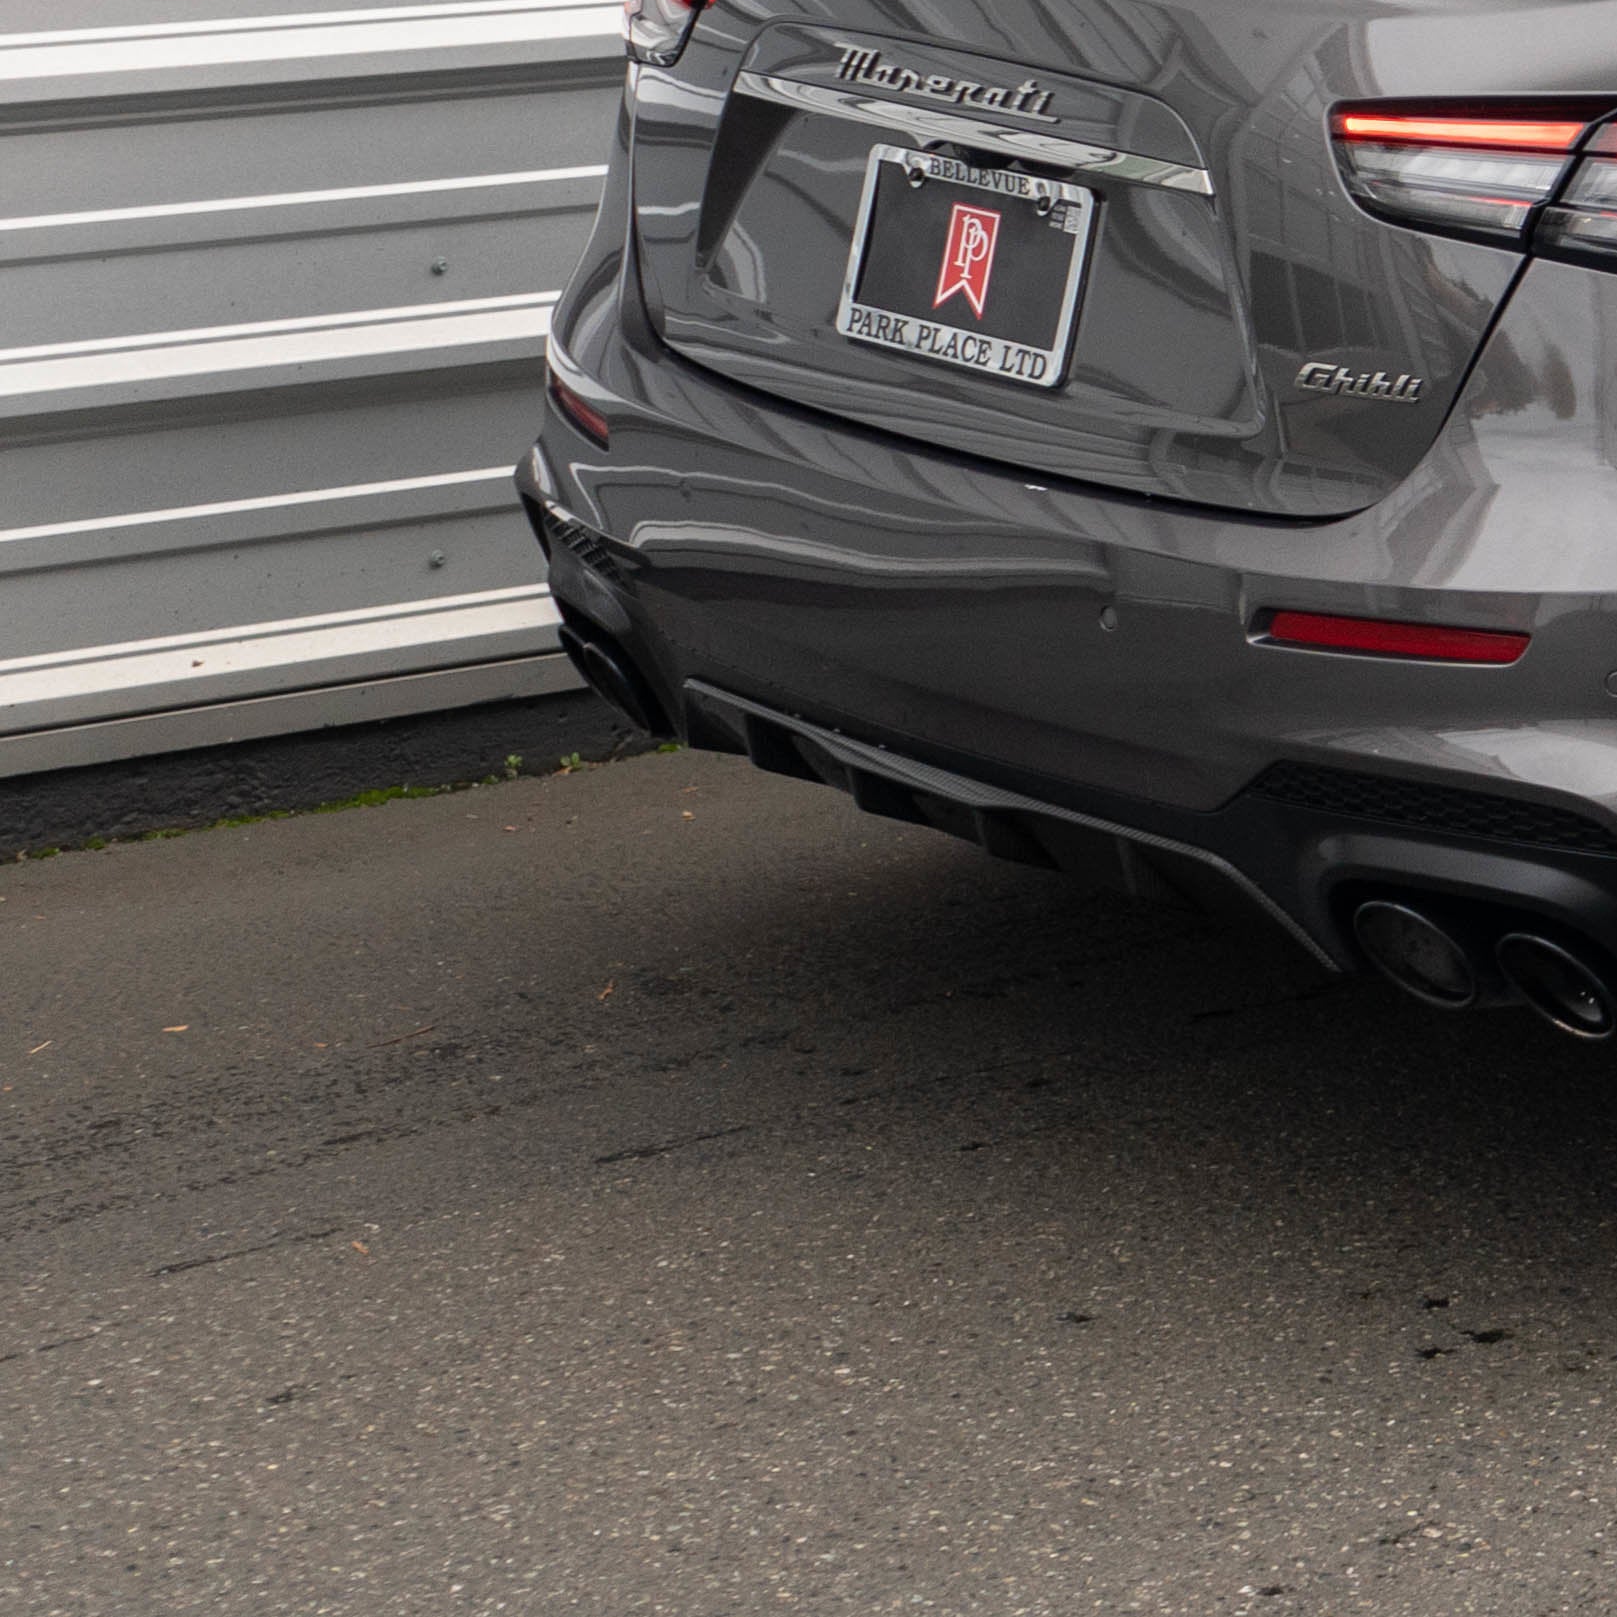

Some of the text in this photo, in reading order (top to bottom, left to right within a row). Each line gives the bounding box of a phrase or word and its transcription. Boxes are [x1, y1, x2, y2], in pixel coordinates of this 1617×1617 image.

[834, 41, 1062, 124] Maserati
[930, 157, 1030, 196] BELLEVUE
[847, 307, 1048, 381] PARK PLACE LTD
[1295, 362, 1423, 403] Ghibli
